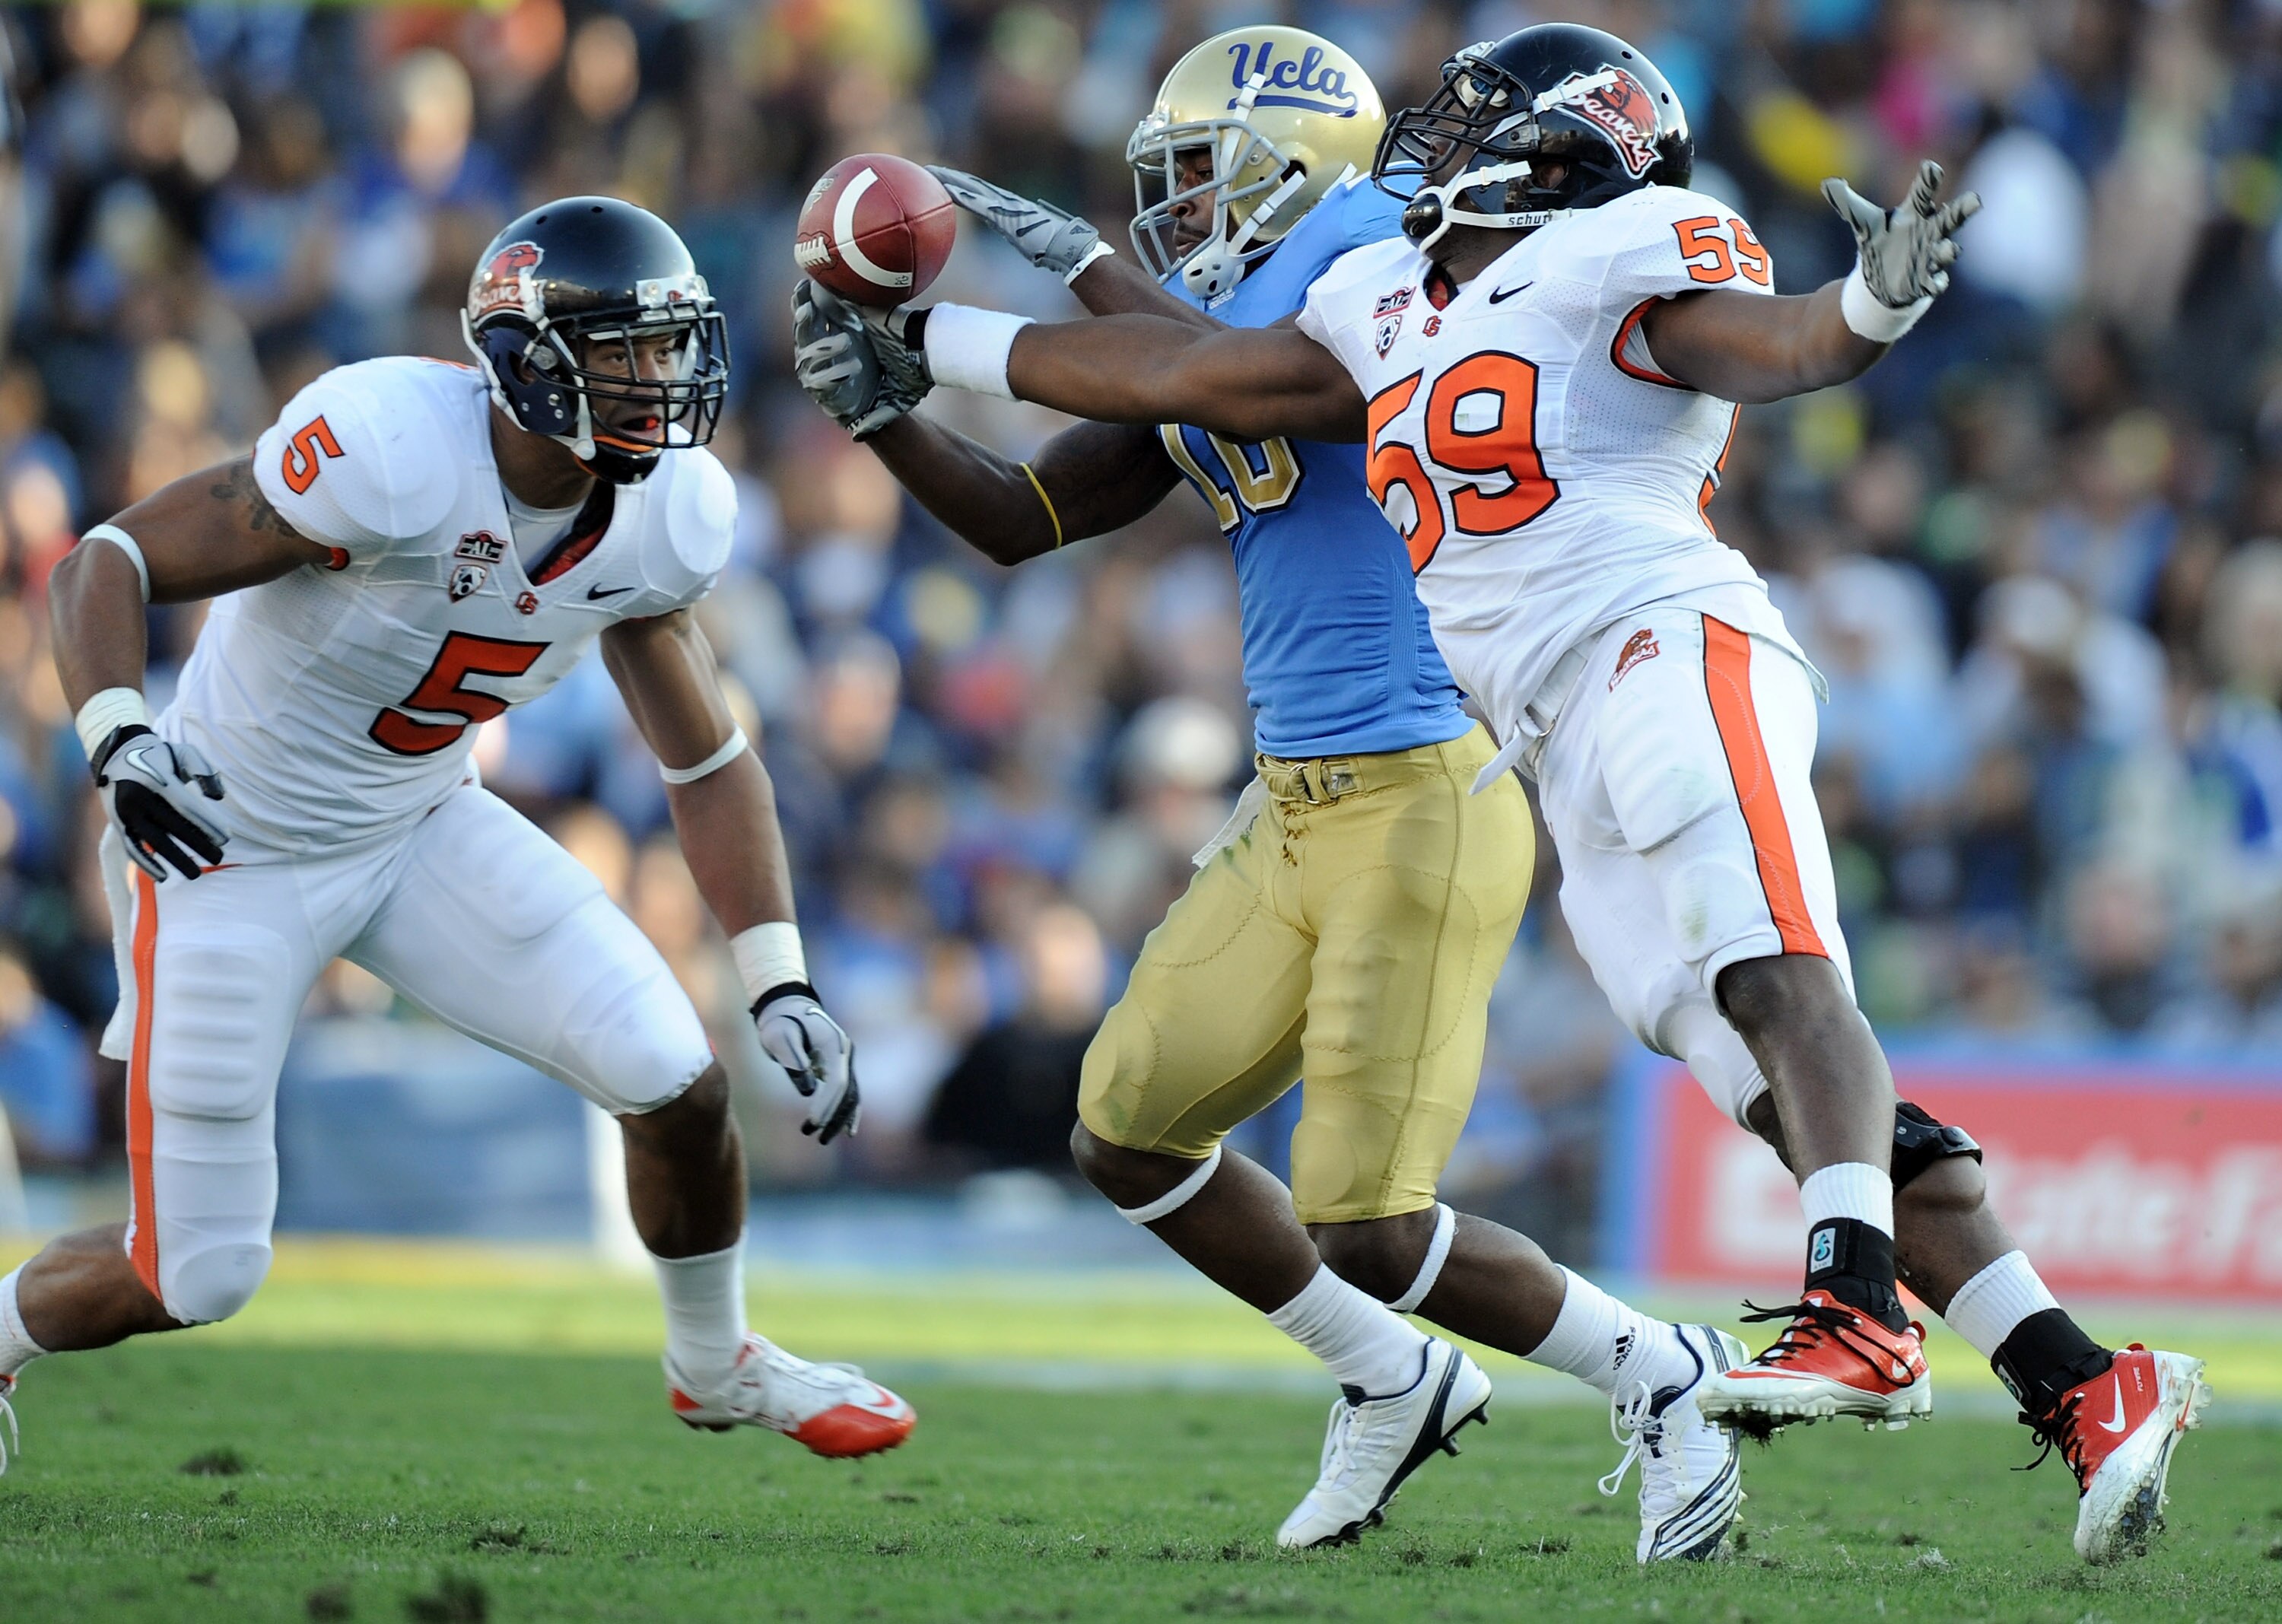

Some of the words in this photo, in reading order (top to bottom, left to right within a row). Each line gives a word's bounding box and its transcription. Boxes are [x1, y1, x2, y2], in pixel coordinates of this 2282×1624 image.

[1228, 41, 1359, 106] Ucla
[1671, 216, 1769, 286] 59
[281, 415, 345, 495] 5
[1366, 349, 1562, 577] 59
[367, 630, 552, 756] 5
